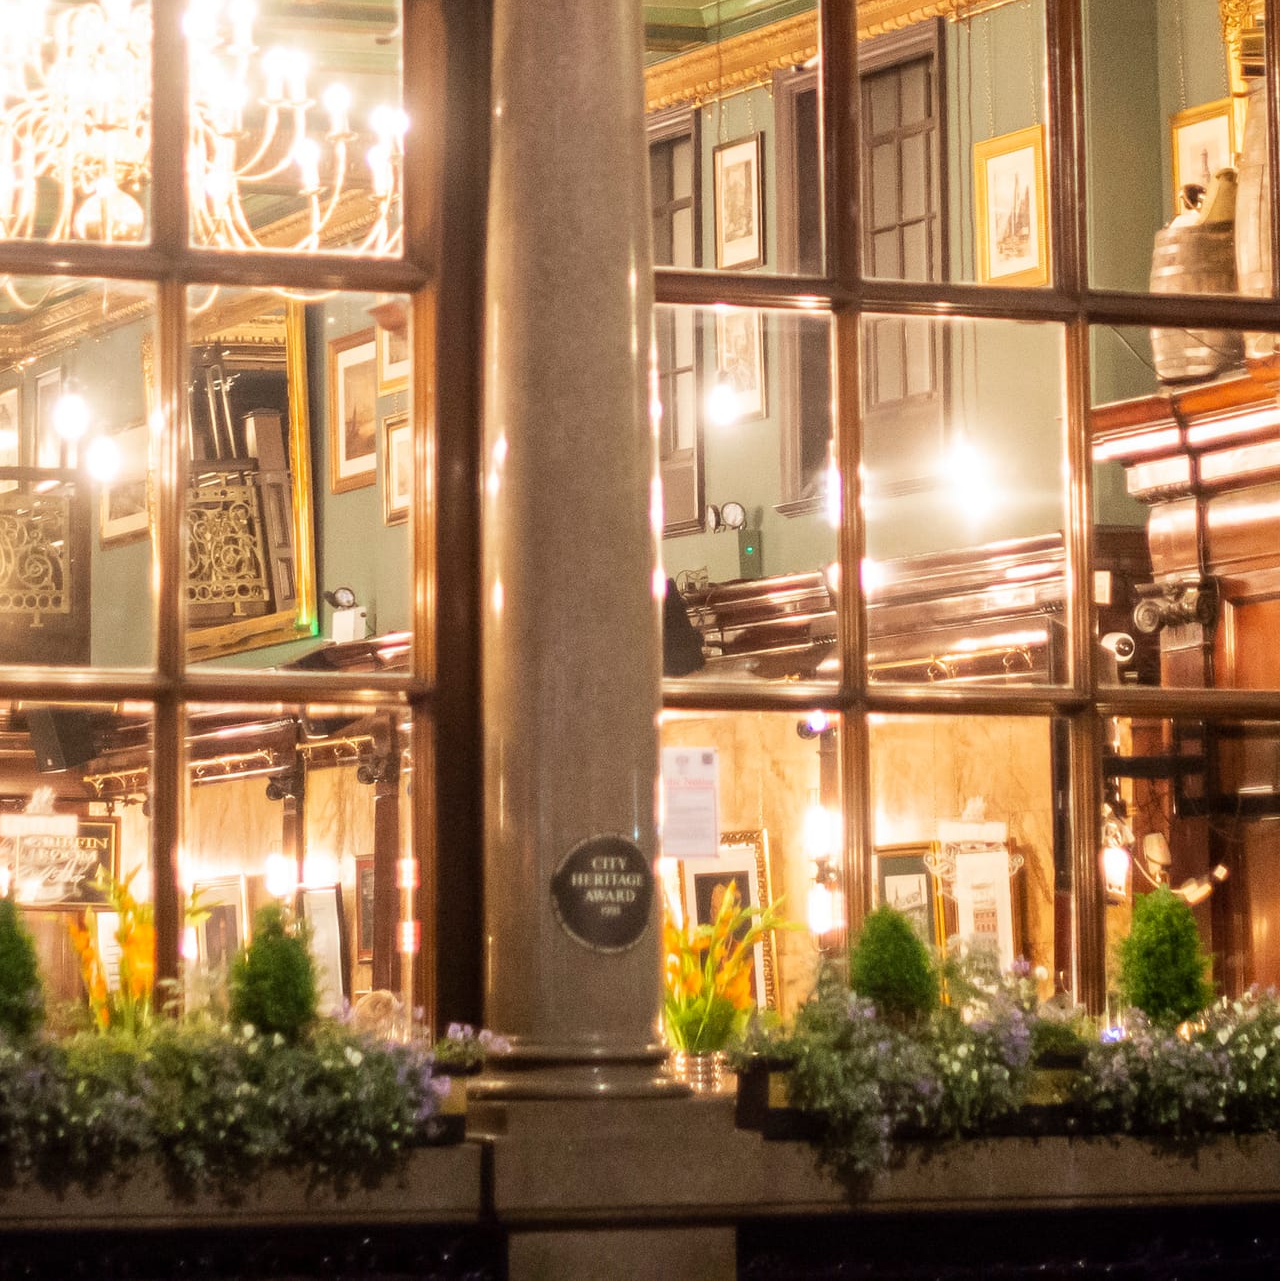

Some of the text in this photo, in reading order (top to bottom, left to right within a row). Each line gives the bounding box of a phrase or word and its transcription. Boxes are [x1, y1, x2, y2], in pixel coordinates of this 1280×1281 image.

[591, 856, 627, 870] CITY
[571, 872, 642, 887] HERITAGE
[584, 888, 636, 903] AWARD
